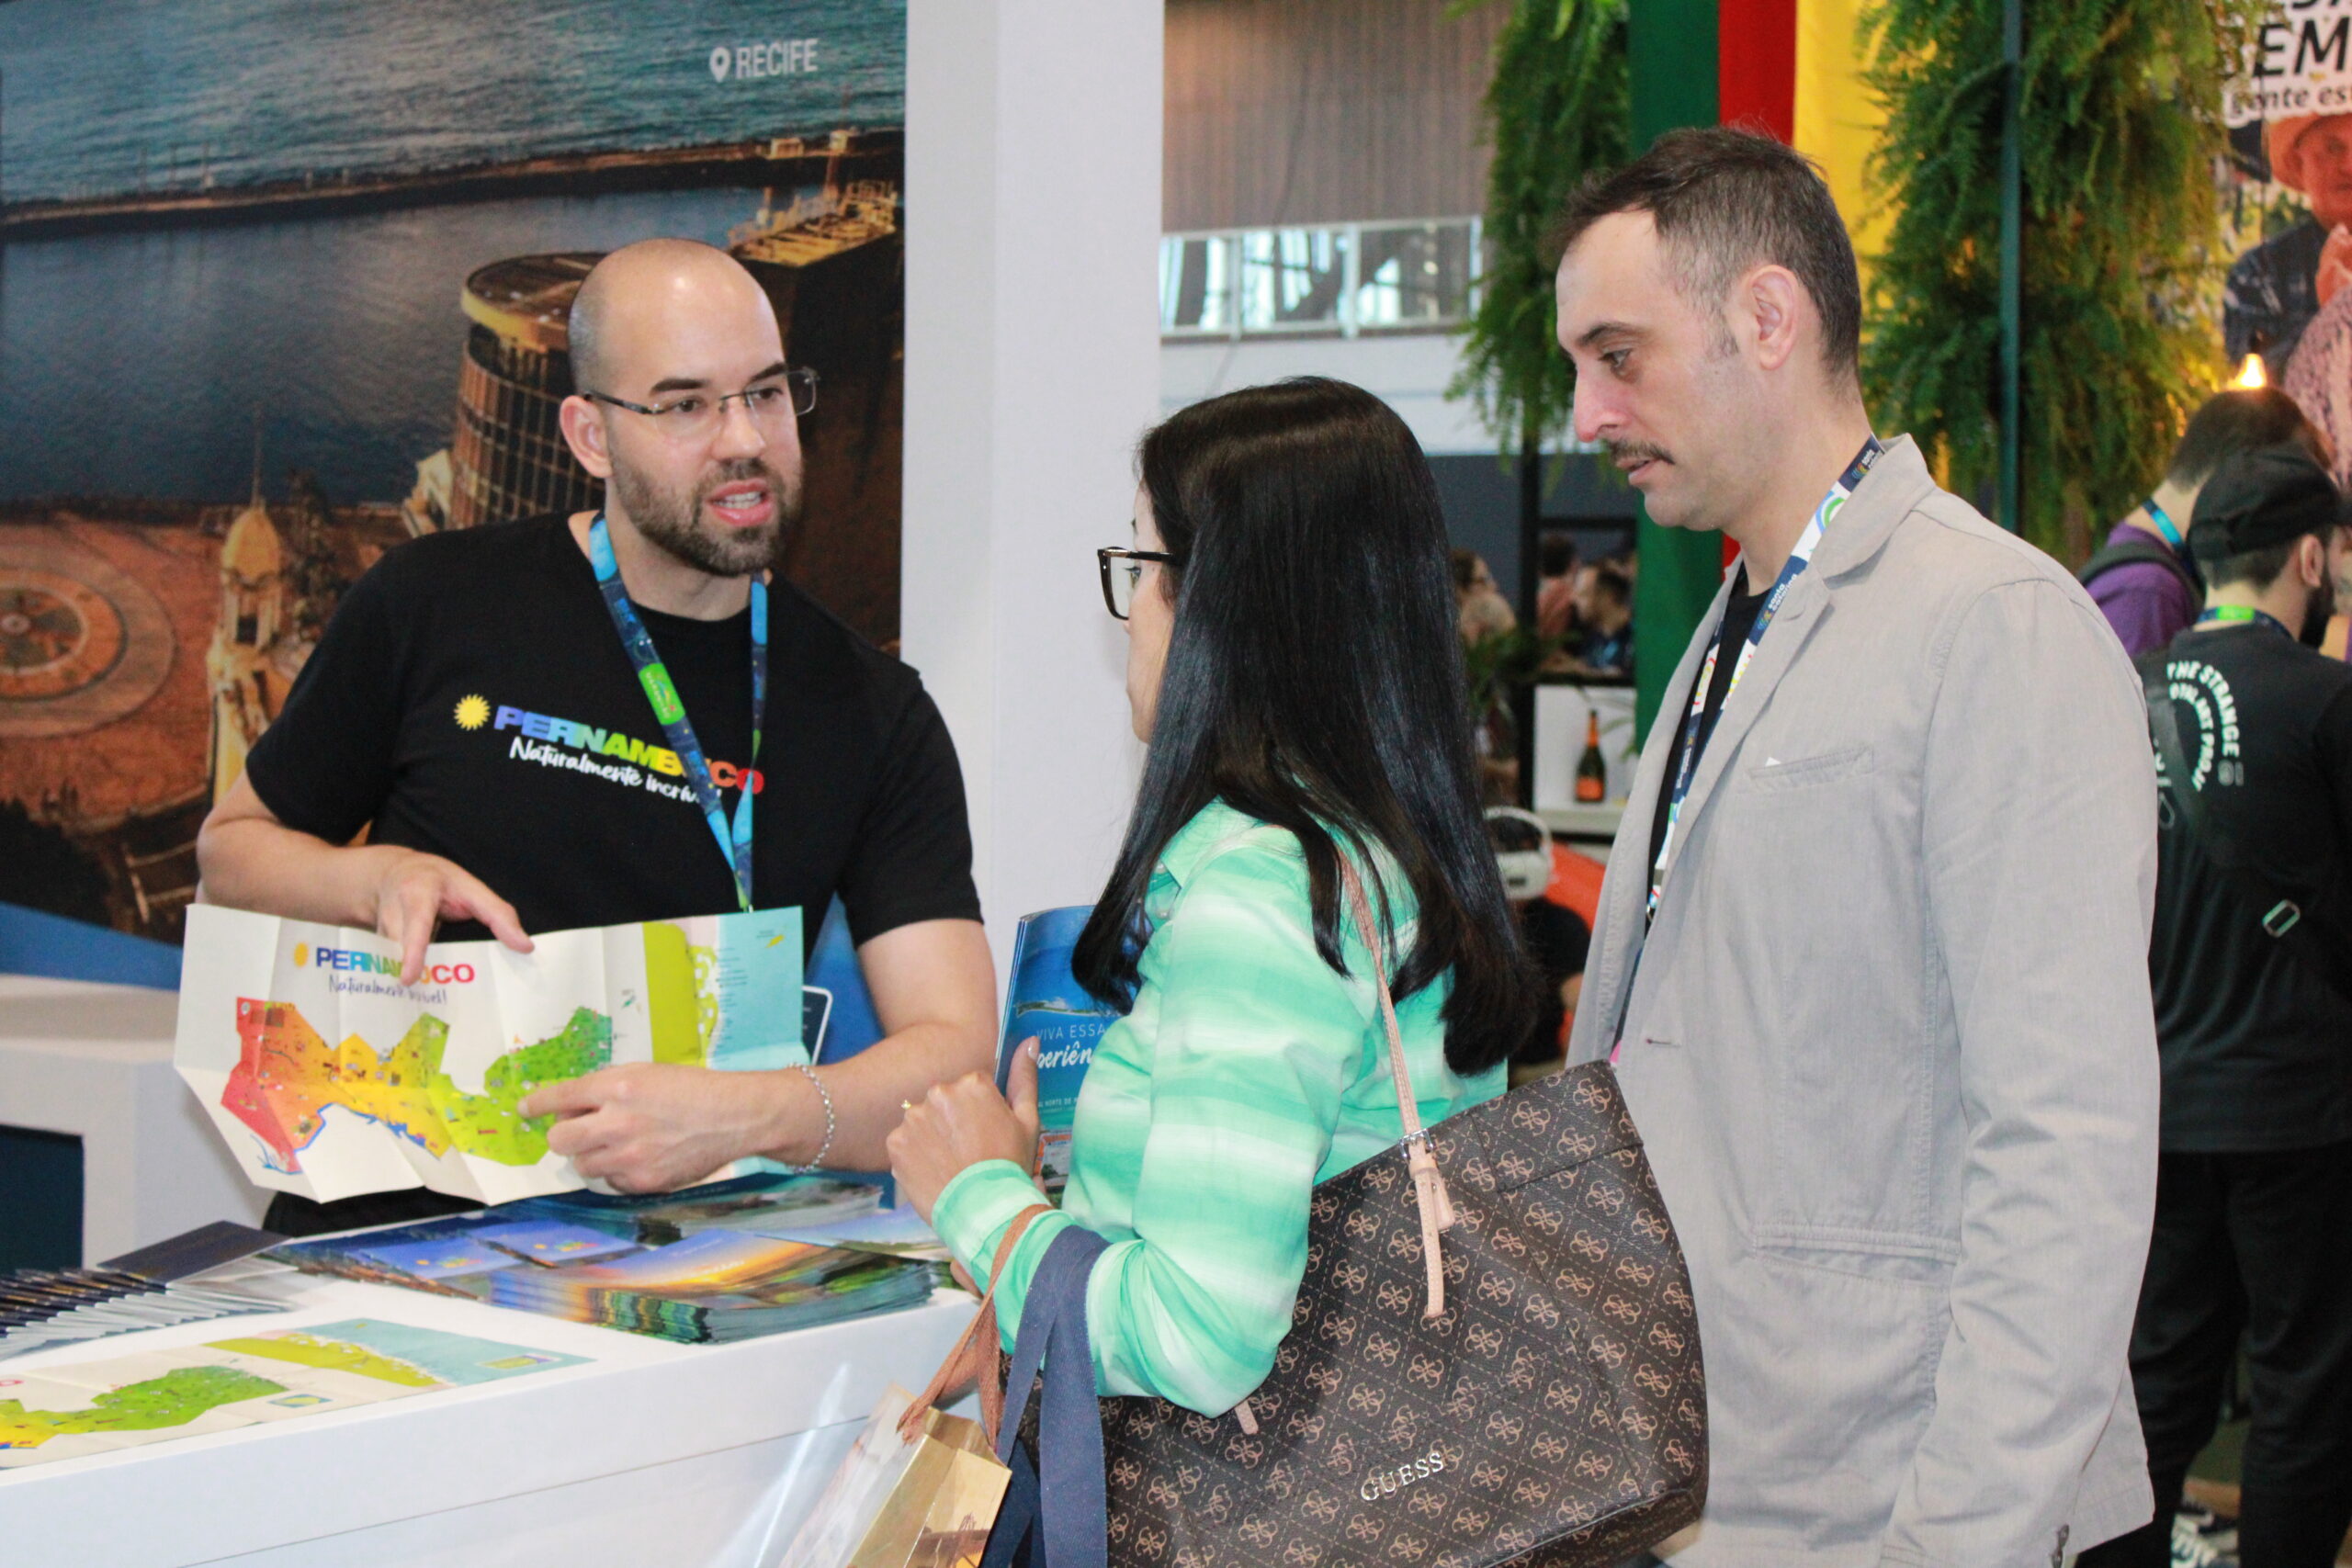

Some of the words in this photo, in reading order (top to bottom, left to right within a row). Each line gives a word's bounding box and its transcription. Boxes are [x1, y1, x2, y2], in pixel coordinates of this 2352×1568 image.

[735, 38, 820, 80] RECIFE
[493, 705, 765, 795] PERNAMBCO
[509, 735, 644, 787] Naturalmente
[1035, 1025, 1064, 1042] VIVA
[1069, 1022, 1106, 1039] ESSA
[1360, 1451, 1444, 1501] GUESS
